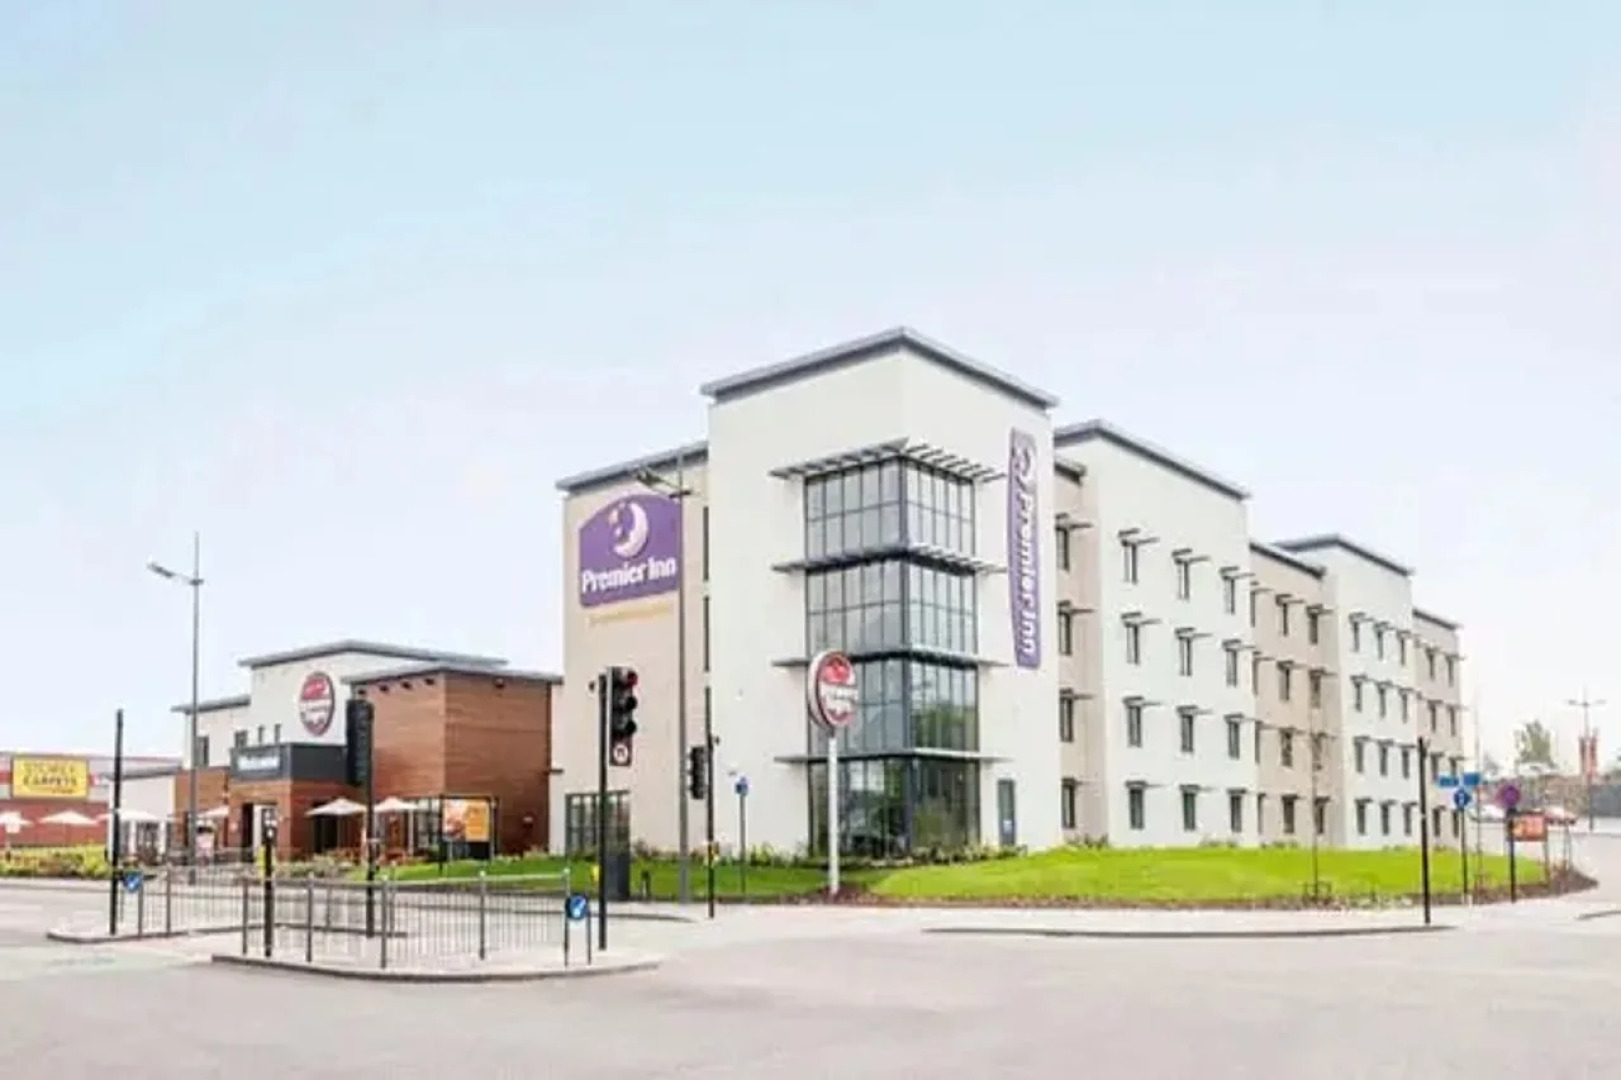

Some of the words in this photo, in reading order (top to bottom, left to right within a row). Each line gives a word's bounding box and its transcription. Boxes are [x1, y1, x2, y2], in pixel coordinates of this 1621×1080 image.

[1019, 493, 1036, 607] Premier
[582, 561, 648, 594] Premier
[647, 557, 677, 581] Inn
[1021, 608, 1037, 656] Inn
